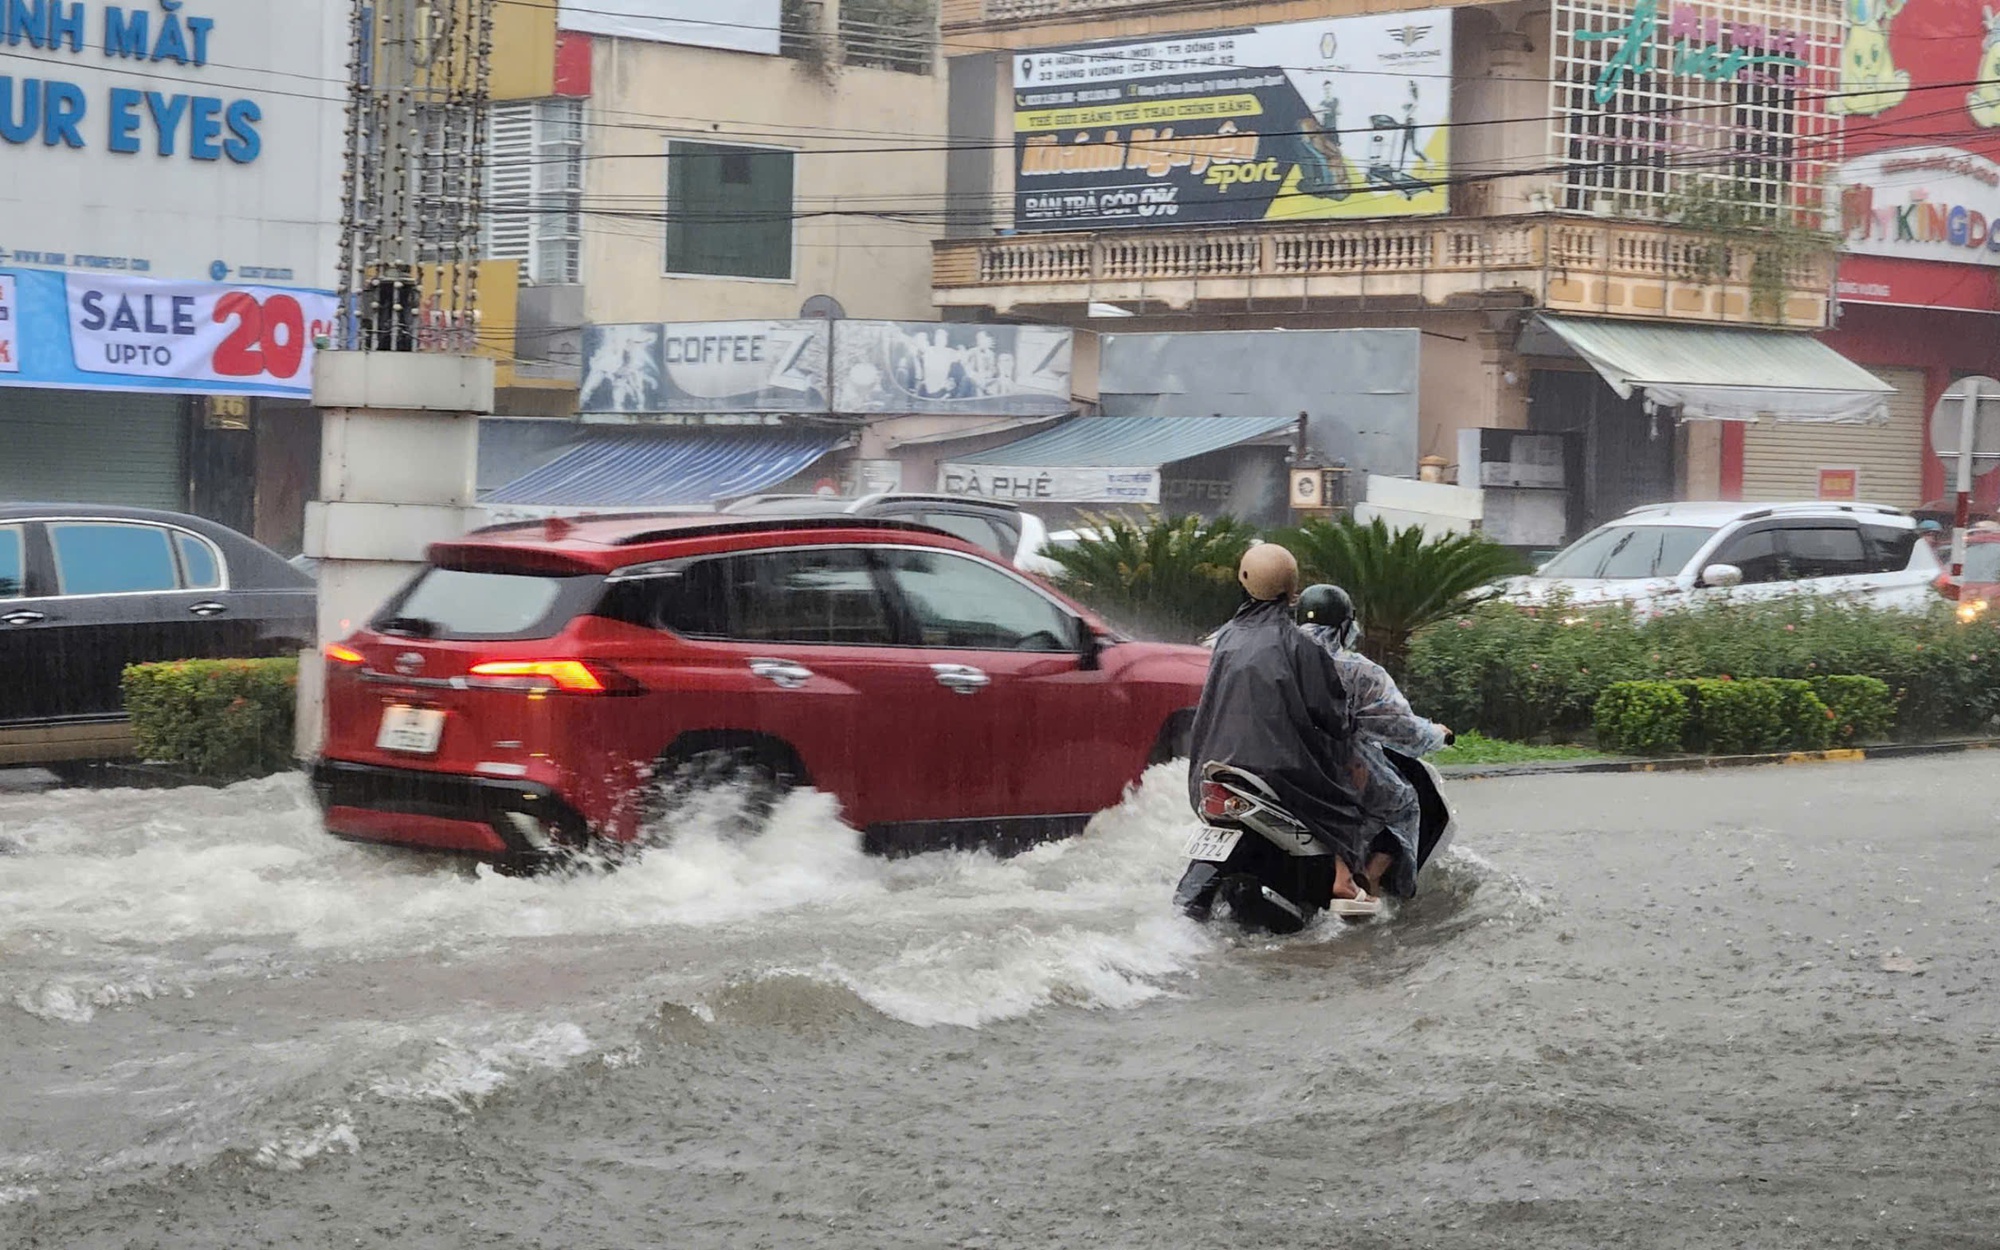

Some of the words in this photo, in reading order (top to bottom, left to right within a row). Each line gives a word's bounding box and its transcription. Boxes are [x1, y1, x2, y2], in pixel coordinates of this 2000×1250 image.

[108, 87, 263, 165] EYES
[1203, 157, 1282, 194] sport
[1138, 187, 1179, 217] 0%
[80, 290, 195, 336] SALE
[105, 343, 172, 366] UPTO
[665, 334, 766, 364] COFFEE
[945, 469, 983, 494] CÀ
[991, 471, 1053, 496] PHÊ
